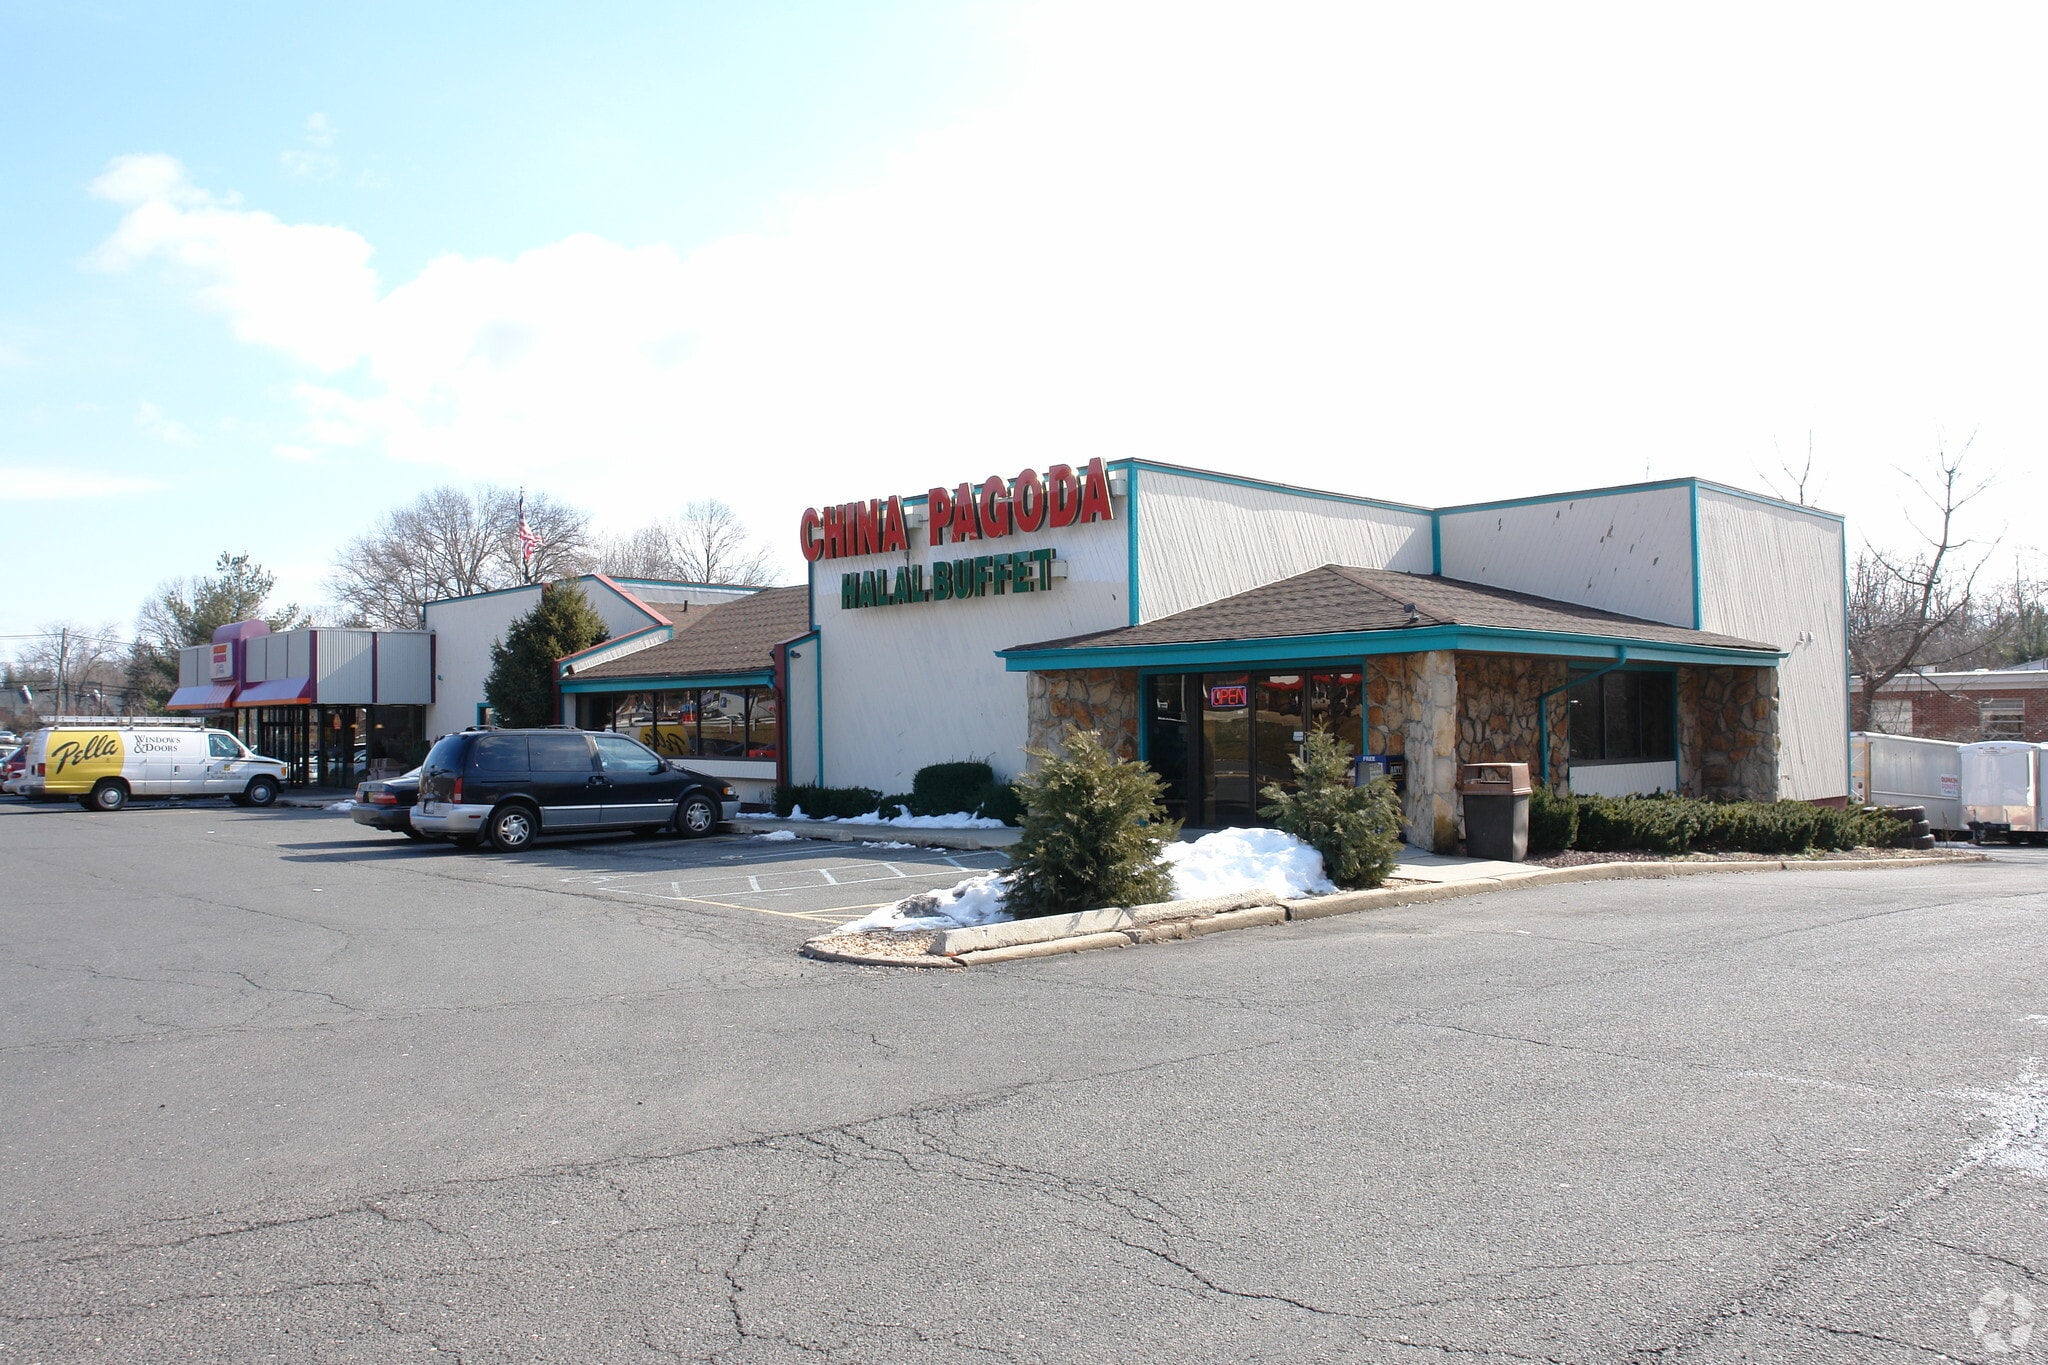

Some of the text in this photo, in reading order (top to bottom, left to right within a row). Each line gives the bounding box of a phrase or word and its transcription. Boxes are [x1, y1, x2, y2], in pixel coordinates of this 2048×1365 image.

[800, 457, 1116, 563] CHINA PAGODA
[841, 548, 1056, 609] HALAL BUFFET
[1213, 688, 1246, 705] OPEN
[51, 734, 118, 775] Pella
